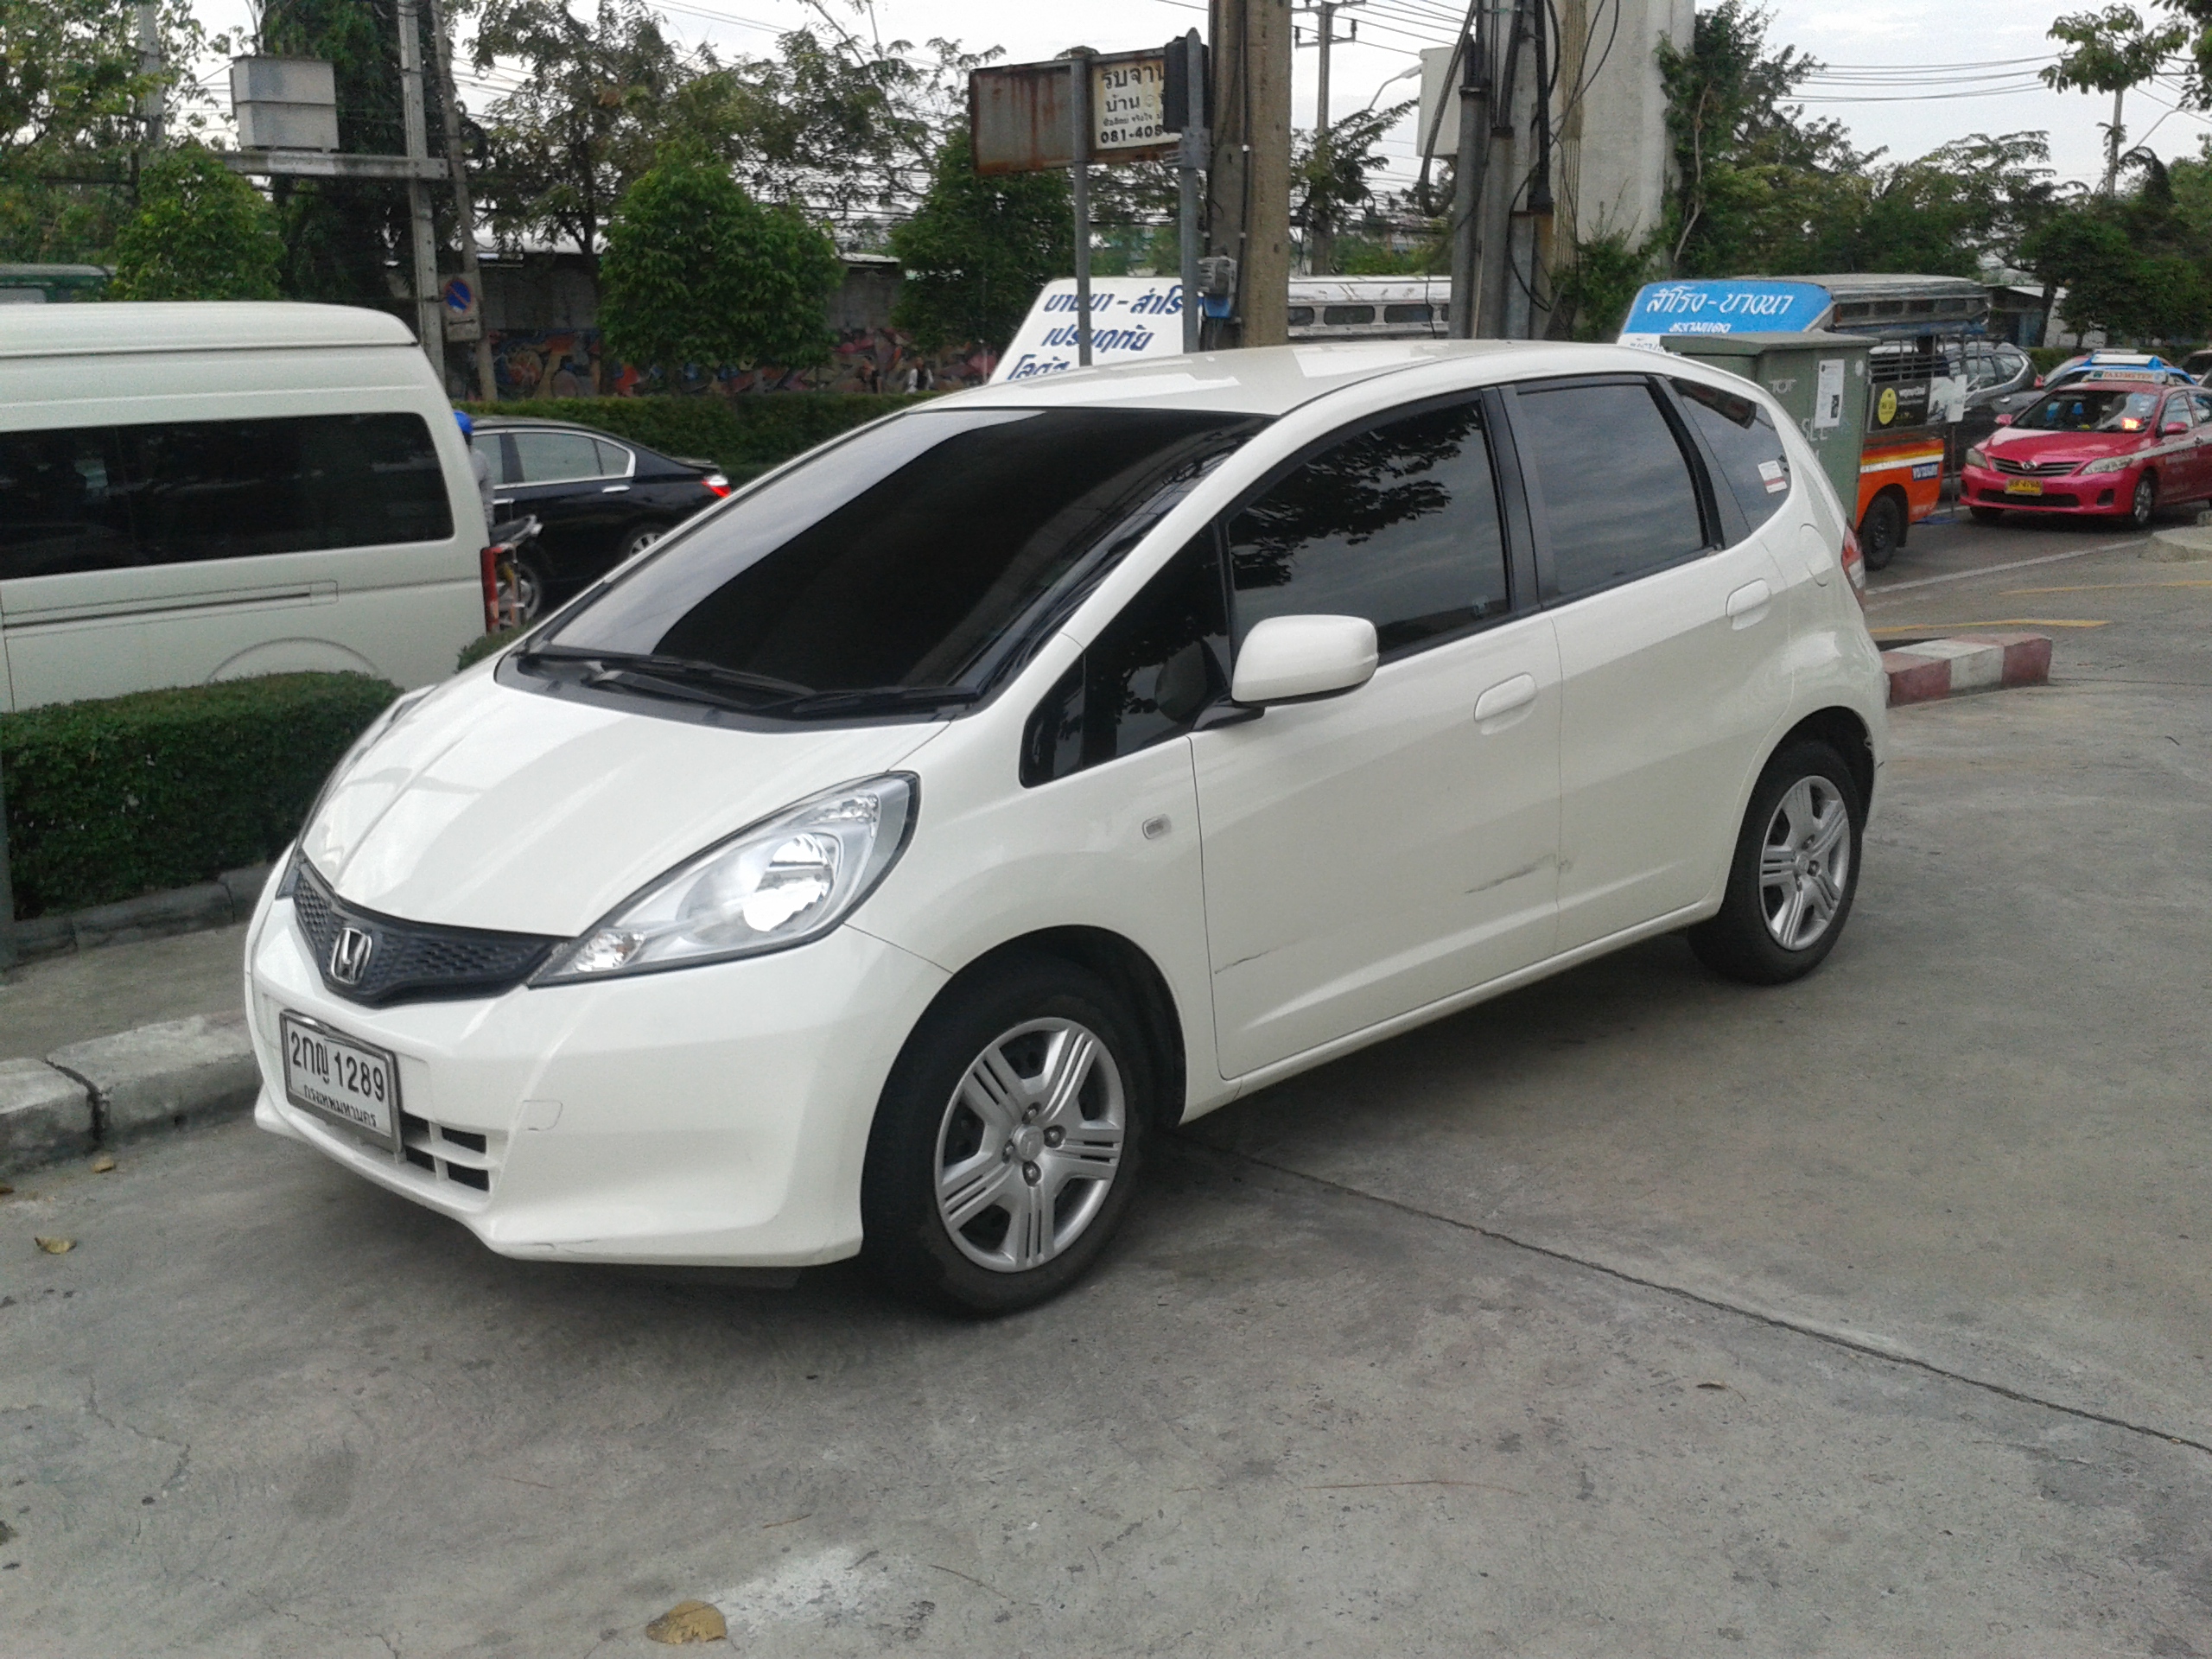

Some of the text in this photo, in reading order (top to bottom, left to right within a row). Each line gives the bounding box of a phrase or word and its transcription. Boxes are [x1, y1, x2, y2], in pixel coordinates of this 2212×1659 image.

[1106, 93, 1141, 112] บ้าน
[1100, 124, 1165, 143] 081-408
[1129, 284, 1184, 315] สำโร
[1646, 285, 1708, 314] สำโรง
[1719, 293, 1795, 315] บางนา
[291, 1030, 385, 1103] 2กญ 1289
